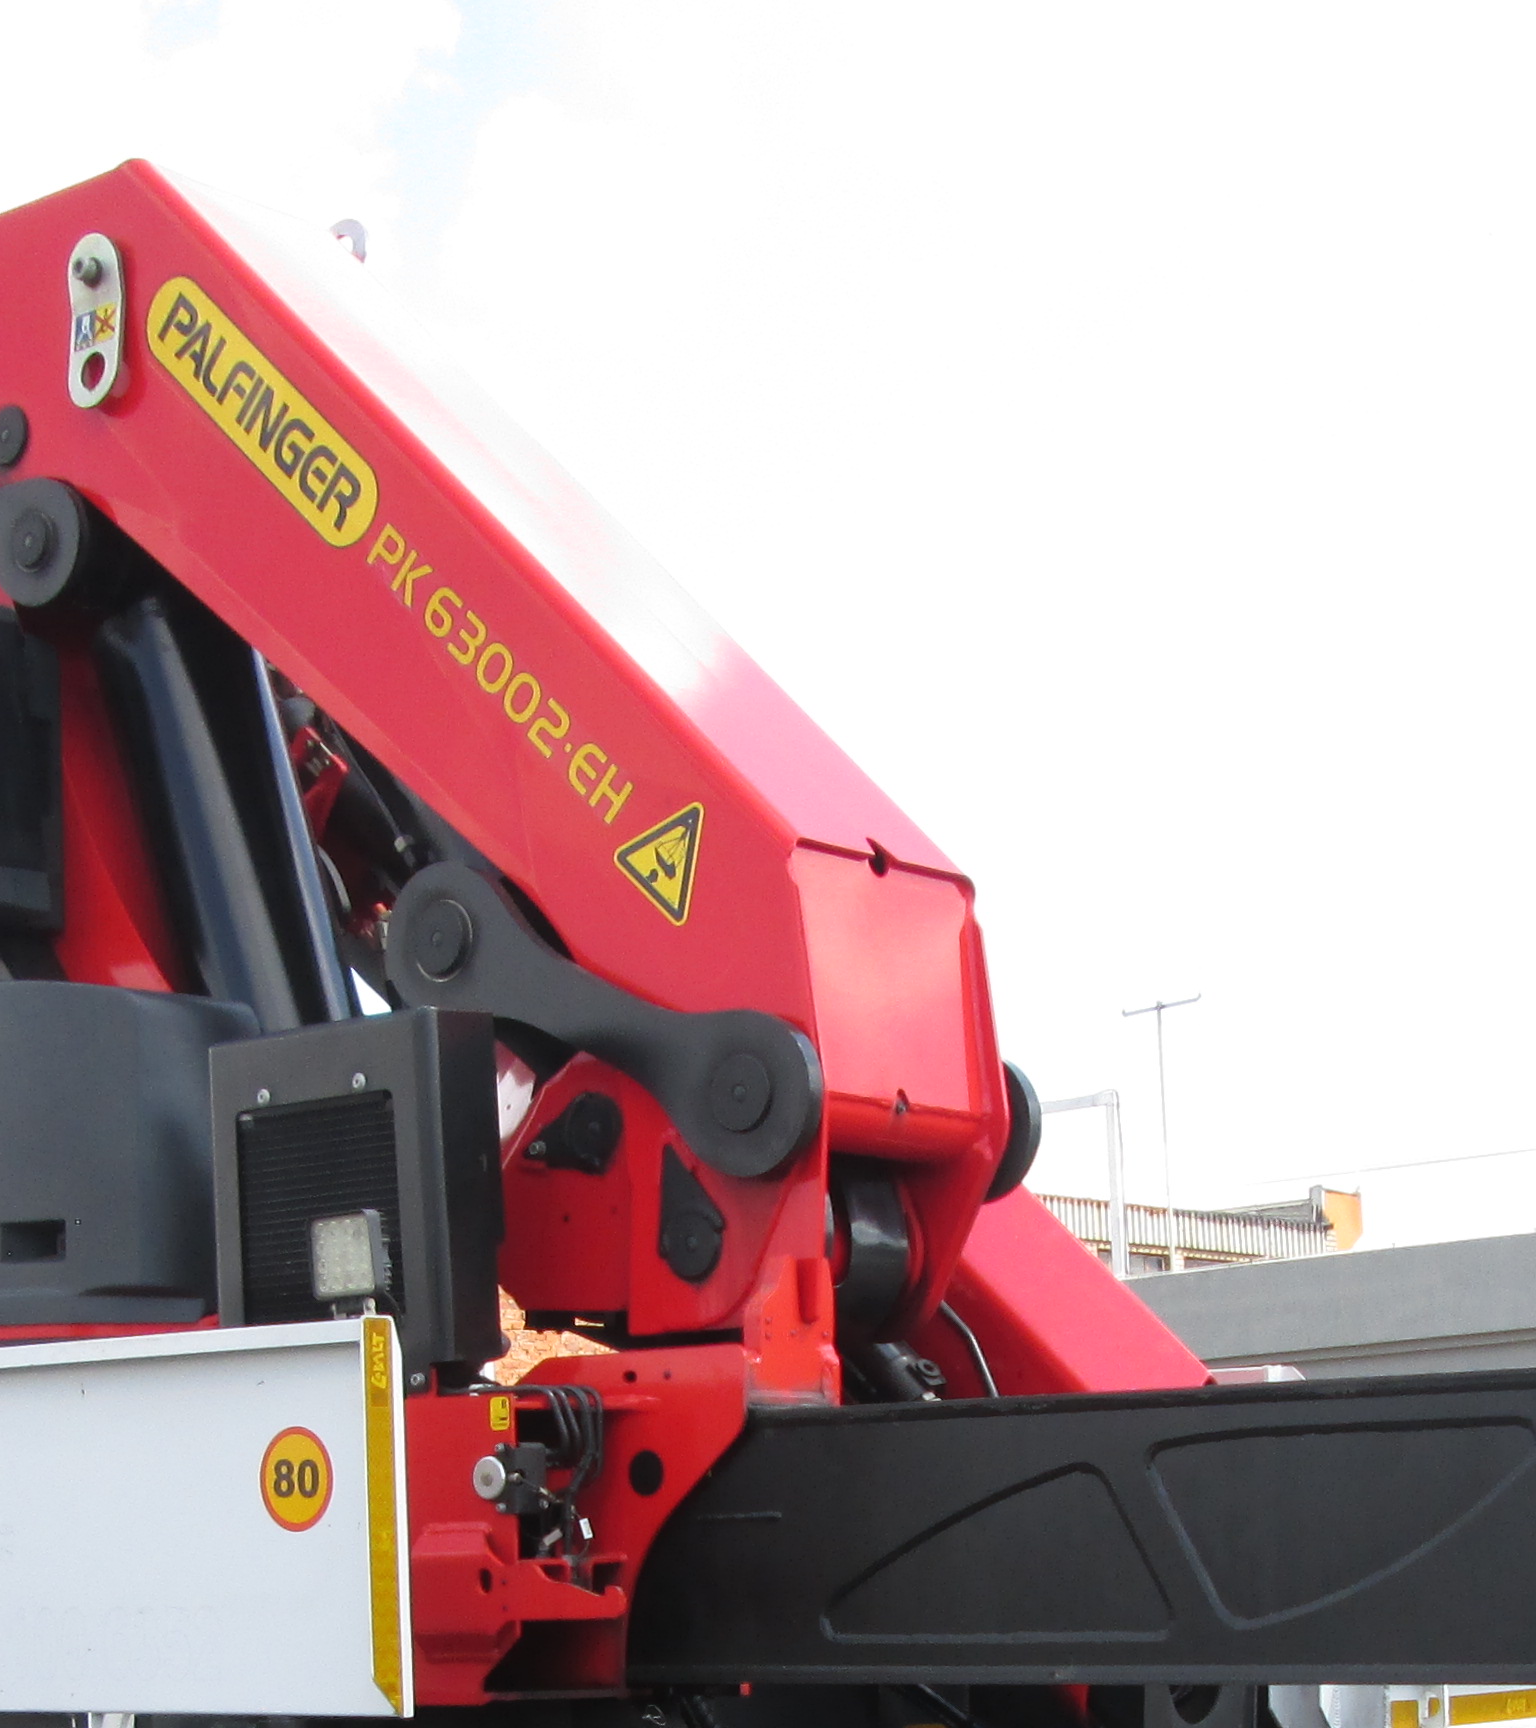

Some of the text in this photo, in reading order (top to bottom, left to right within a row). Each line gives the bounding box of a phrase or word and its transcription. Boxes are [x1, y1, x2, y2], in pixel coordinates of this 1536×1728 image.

[157, 291, 362, 532] PALFINGER
[366, 522, 434, 608] PK
[273, 1458, 320, 1499] 80
